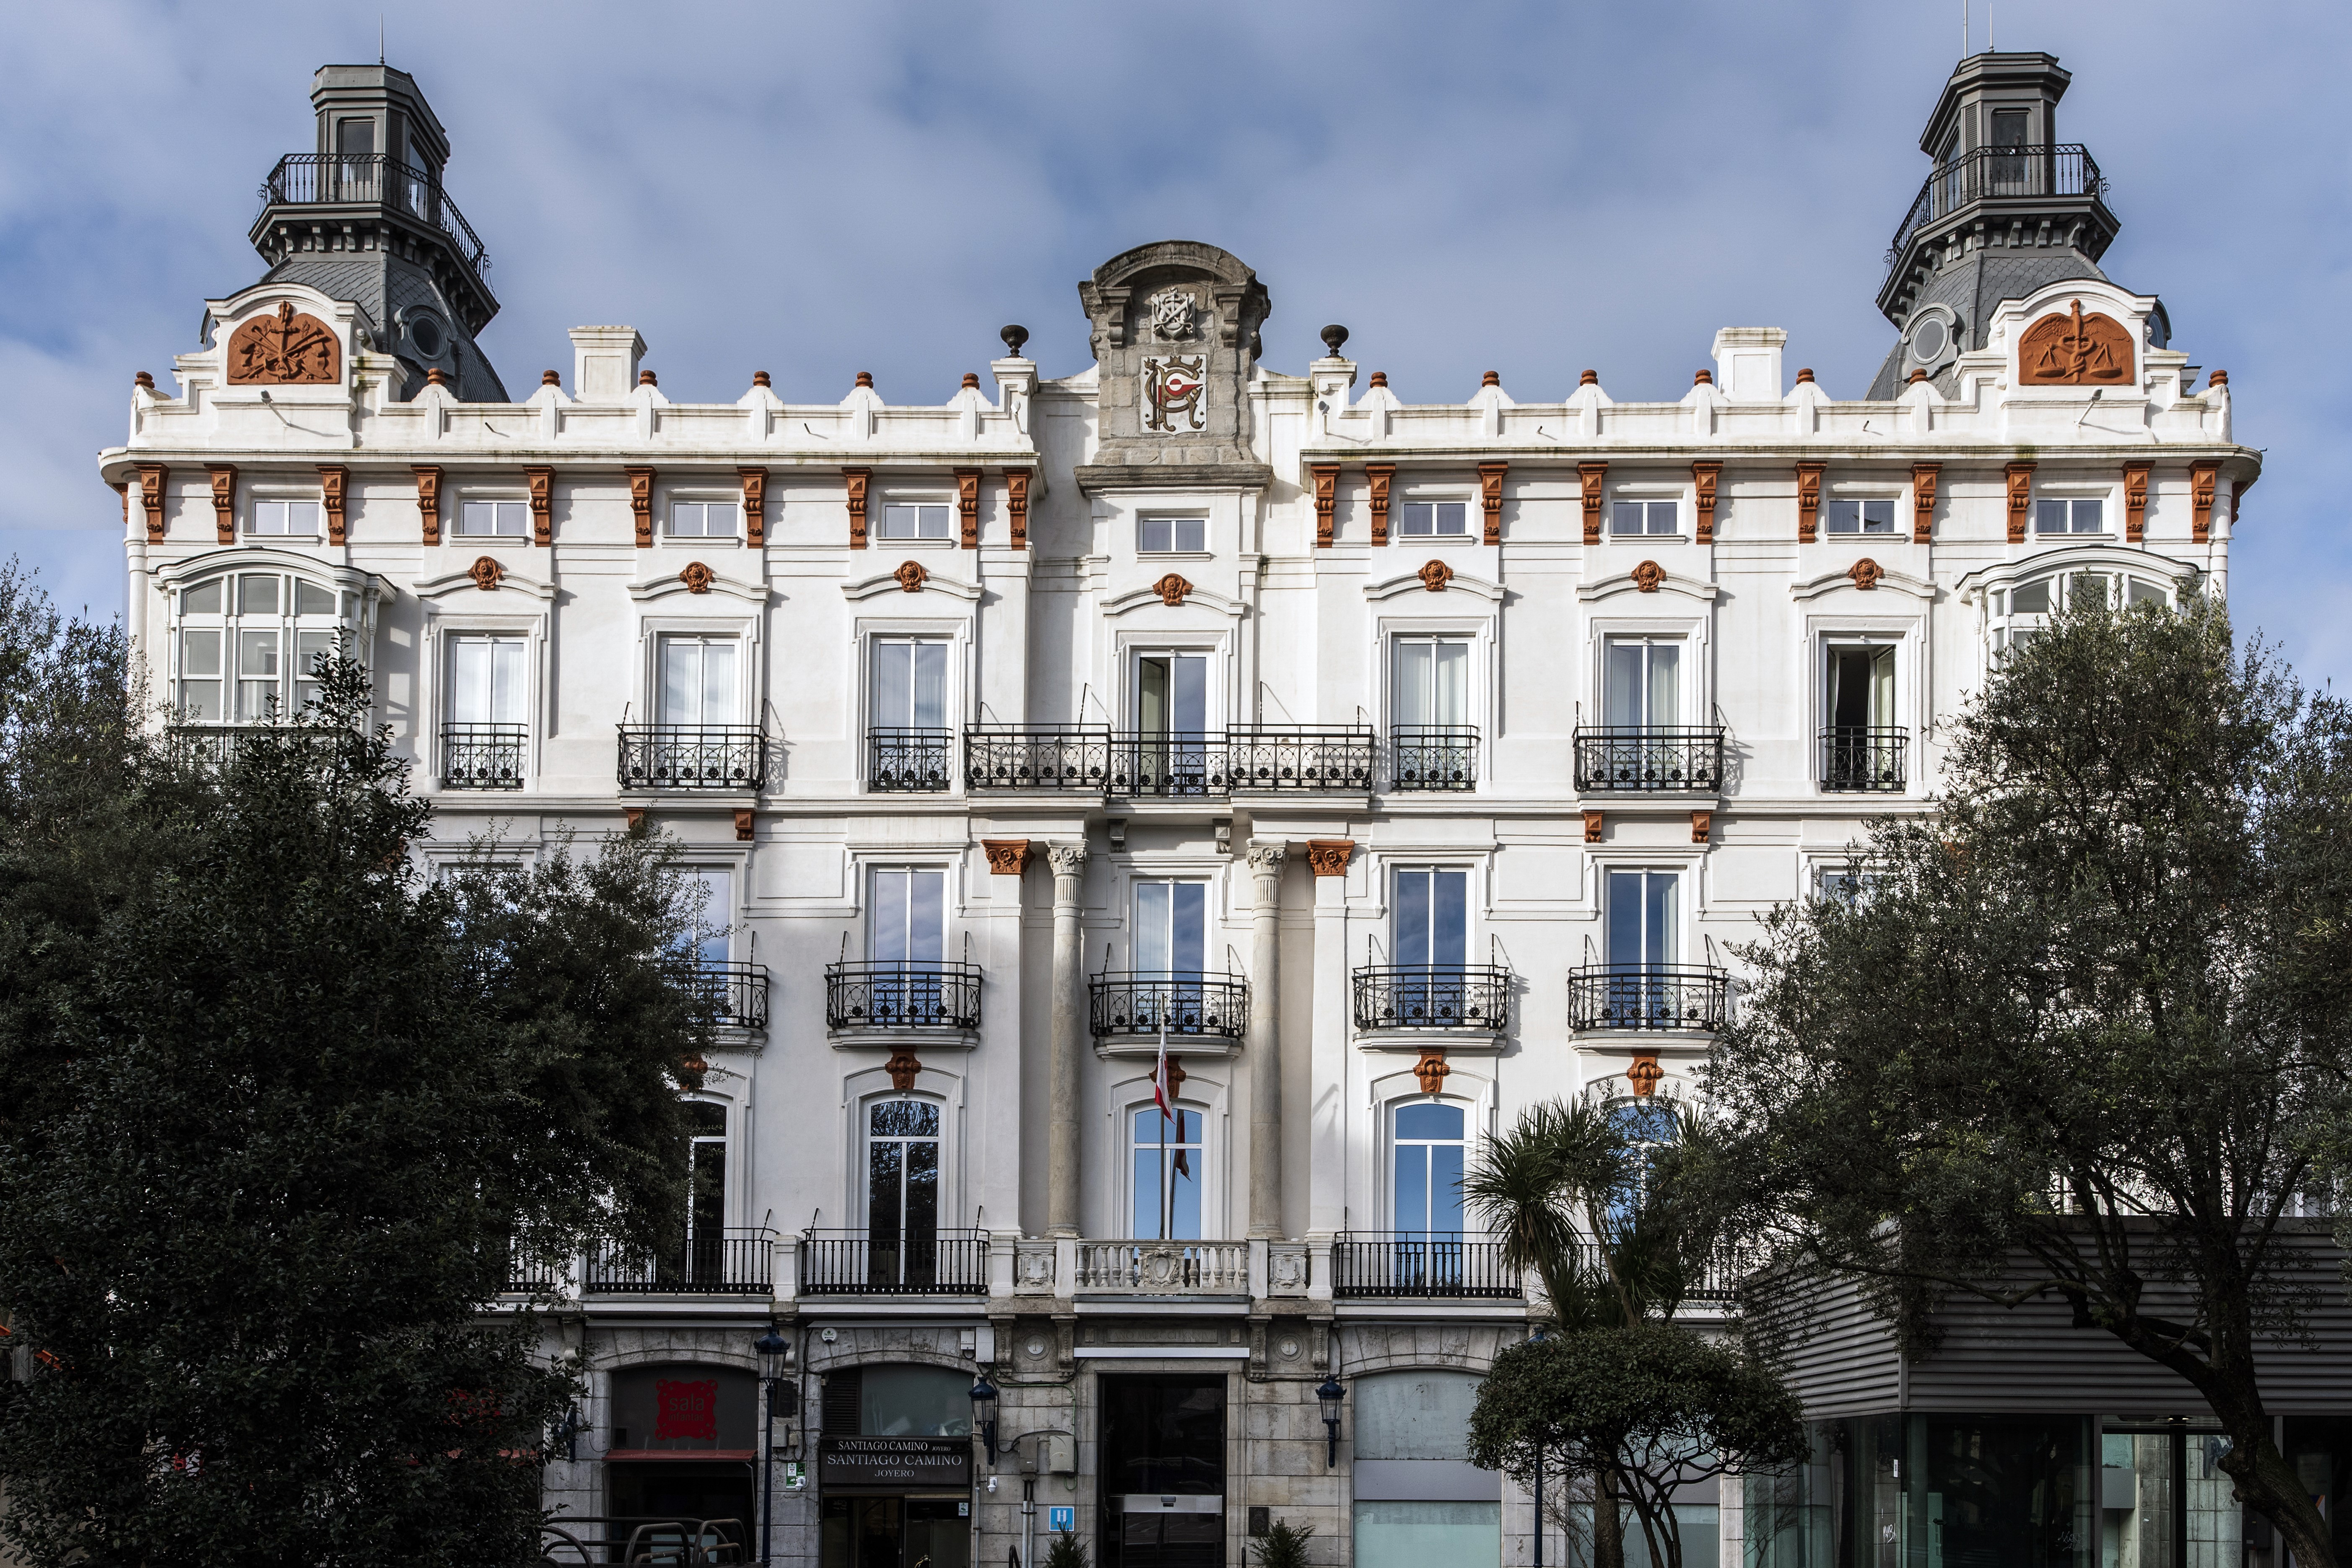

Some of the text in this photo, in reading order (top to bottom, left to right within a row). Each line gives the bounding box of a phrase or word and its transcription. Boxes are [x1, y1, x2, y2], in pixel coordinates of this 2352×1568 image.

[669, 1393, 704, 1411] sala
[668, 1412, 704, 1421] infantas
[839, 1441, 887, 1451] SANTIAGO
[889, 1441, 928, 1451] CAMINO
[828, 1454, 962, 1466] SANTIAGO CAMINO
[1057, 1510, 1067, 1522] H
